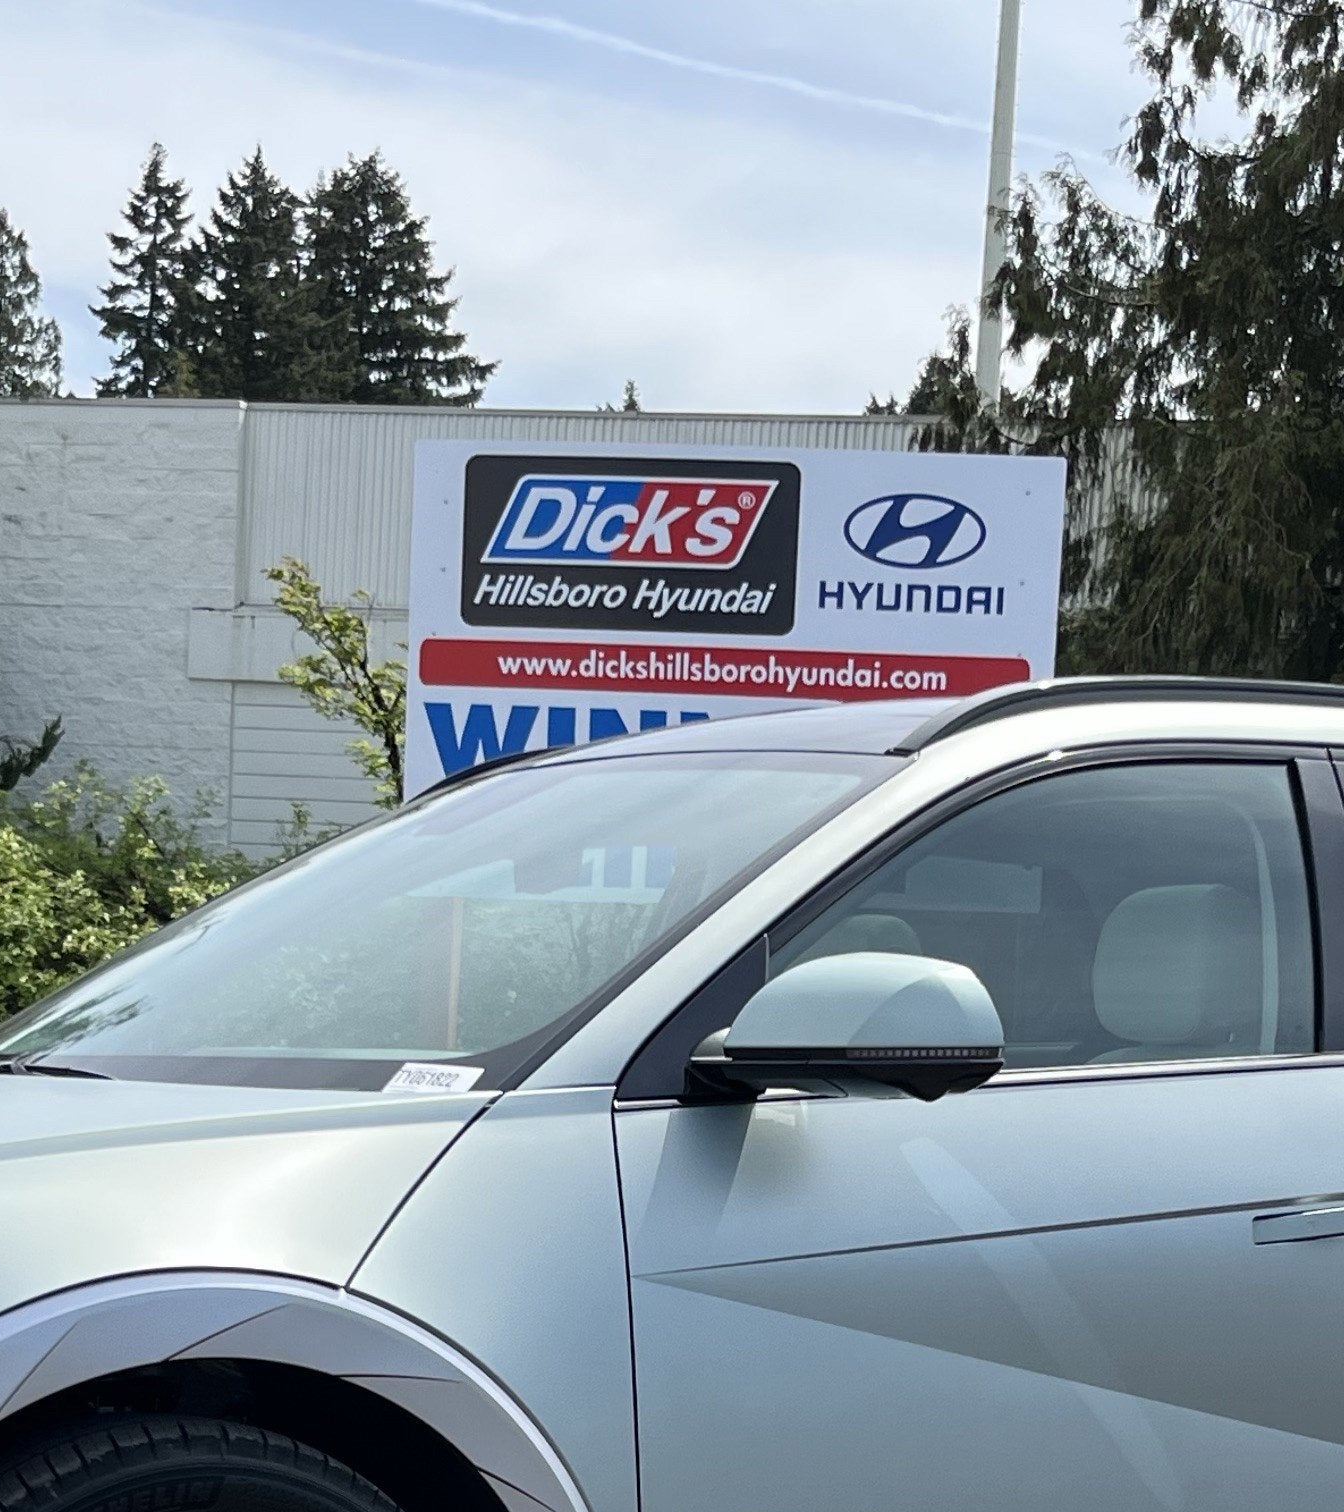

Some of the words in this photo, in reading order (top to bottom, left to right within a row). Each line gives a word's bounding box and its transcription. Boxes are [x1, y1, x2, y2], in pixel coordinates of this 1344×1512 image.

[473, 574, 627, 608] Hillsboro
[632, 580, 777, 618] Hyundai
[818, 580, 1005, 616] HYUNDAI
[497, 650, 947, 693] www.dickshillsborohyundai.com
